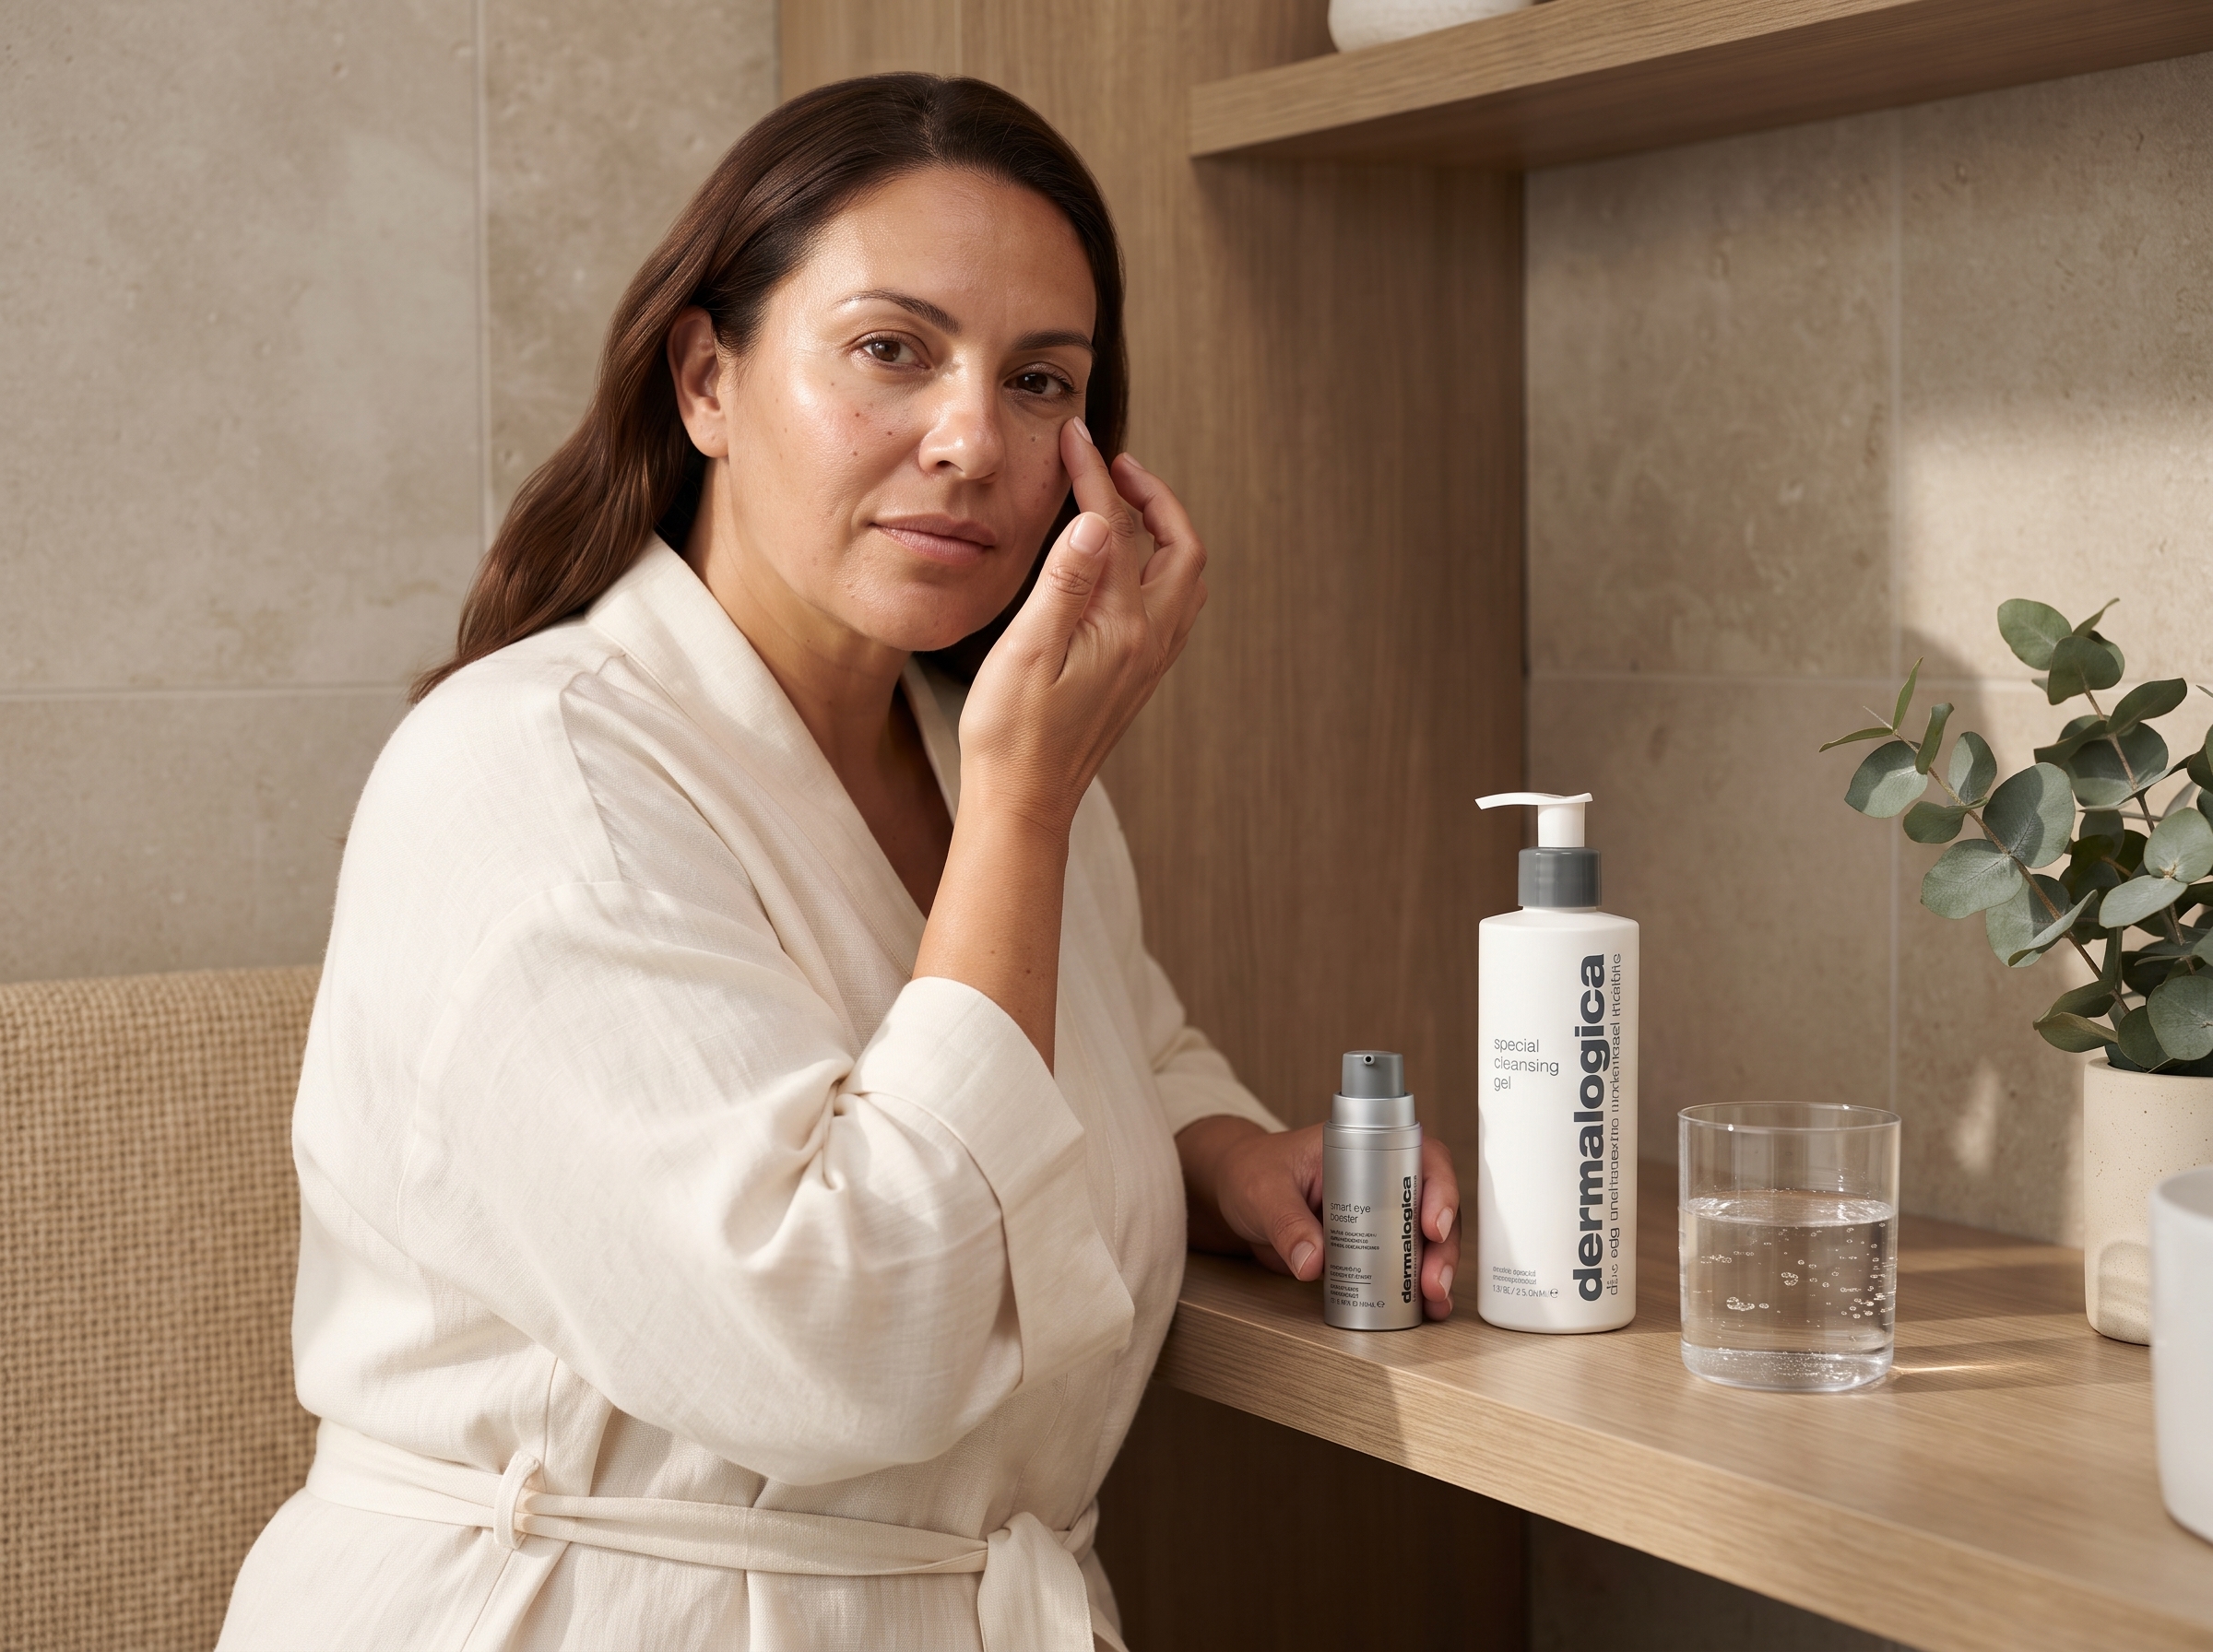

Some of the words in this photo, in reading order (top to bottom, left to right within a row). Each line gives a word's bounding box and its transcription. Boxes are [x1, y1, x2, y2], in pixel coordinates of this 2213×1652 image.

[1494, 1038, 1539, 1053] special
[1494, 1076, 1511, 1092] gel
[1573, 953, 1611, 1302] dermalogica
[1354, 1205, 1371, 1214] eye
[1401, 1175, 1413, 1304] dermalogica
